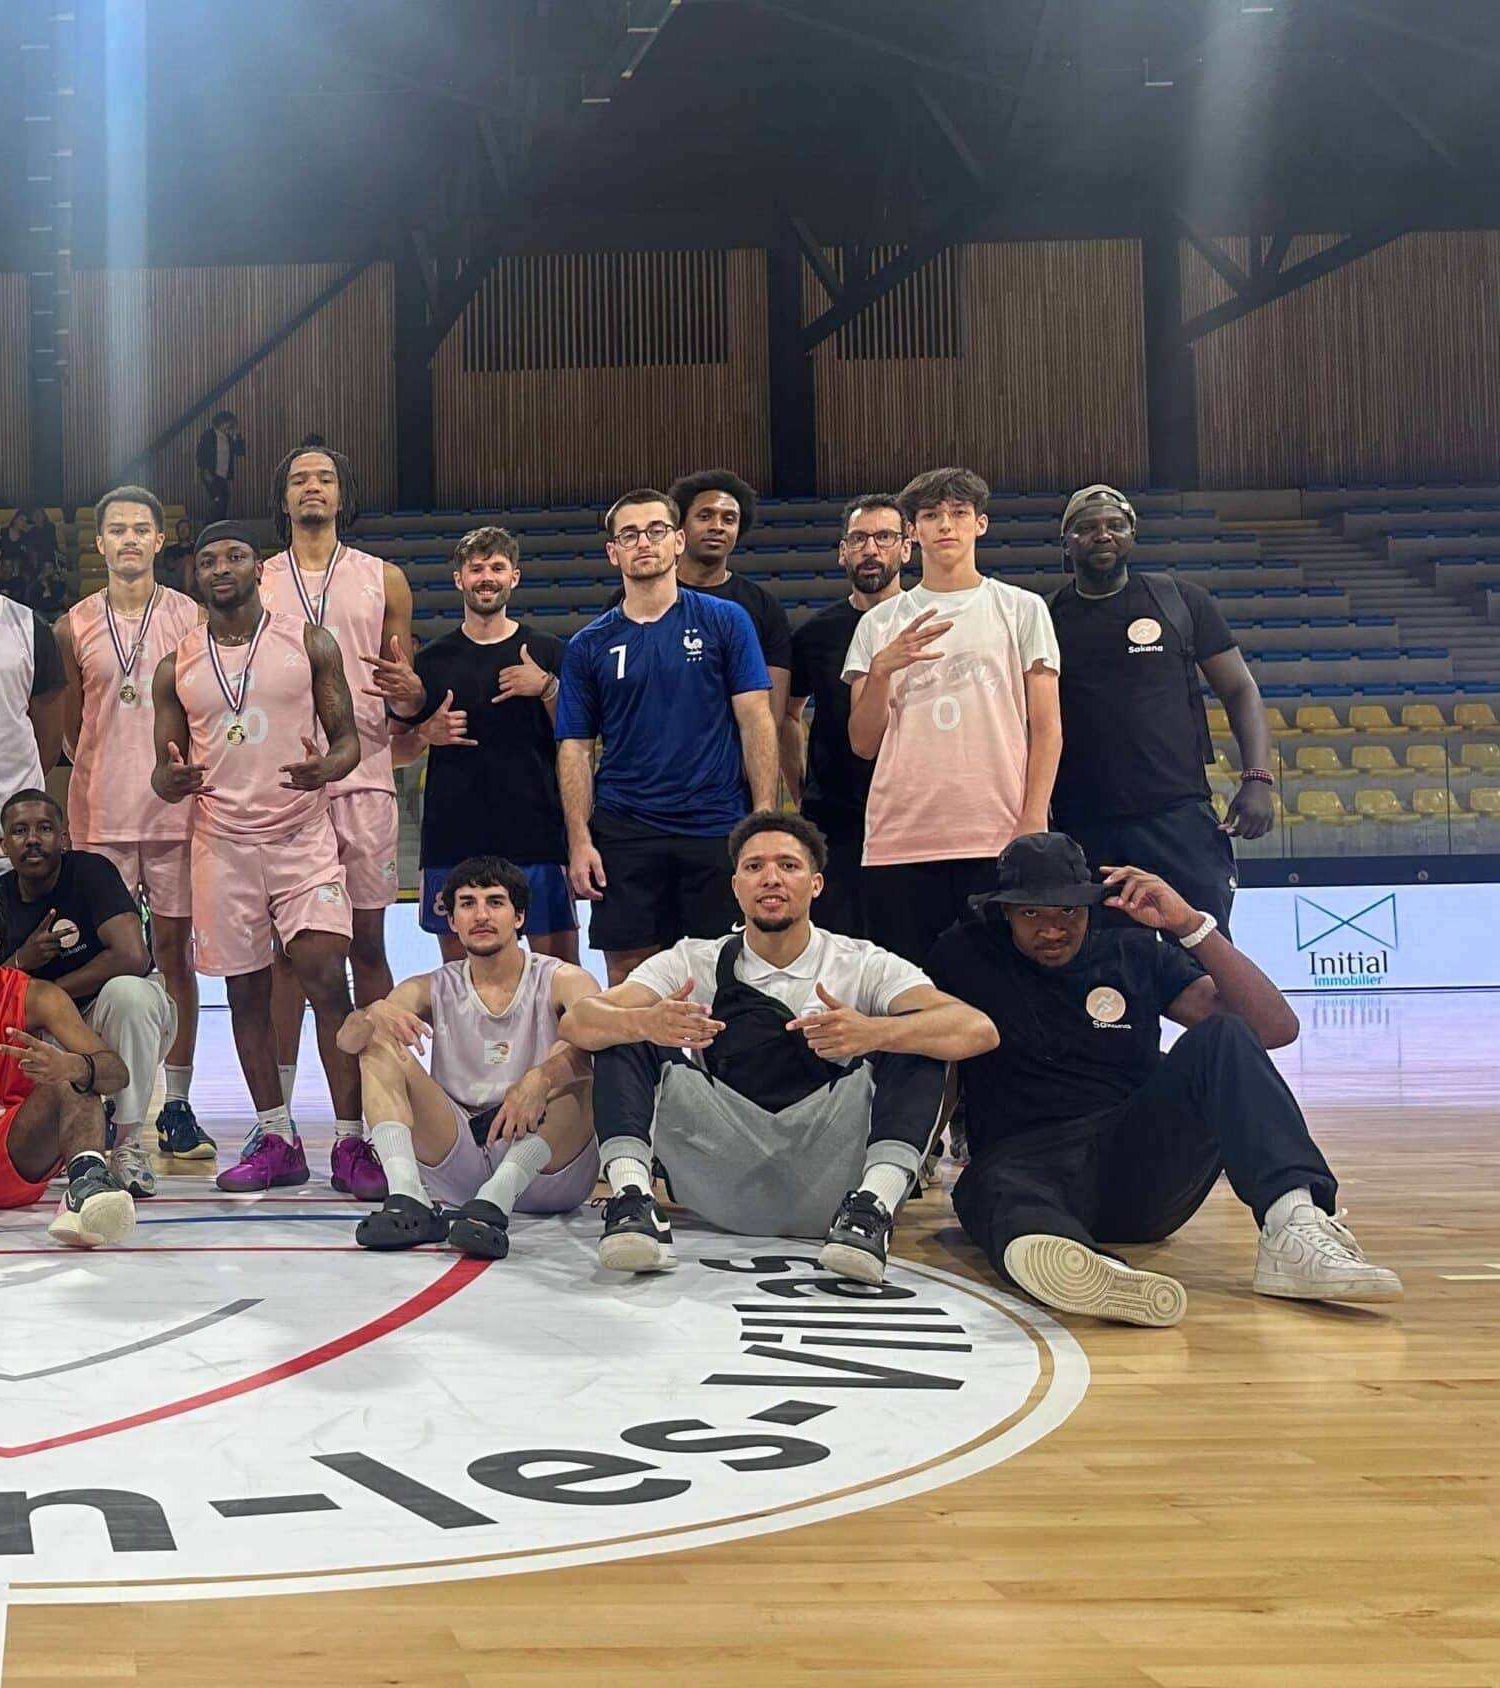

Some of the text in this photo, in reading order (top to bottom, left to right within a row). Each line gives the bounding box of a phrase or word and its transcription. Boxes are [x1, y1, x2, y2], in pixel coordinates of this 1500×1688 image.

[609, 644, 627, 680] 7
[1128, 644, 1164, 654] Sakana
[932, 695, 961, 731] 0
[1308, 949, 1389, 976] Initial
[1314, 974, 1384, 987] immobilier
